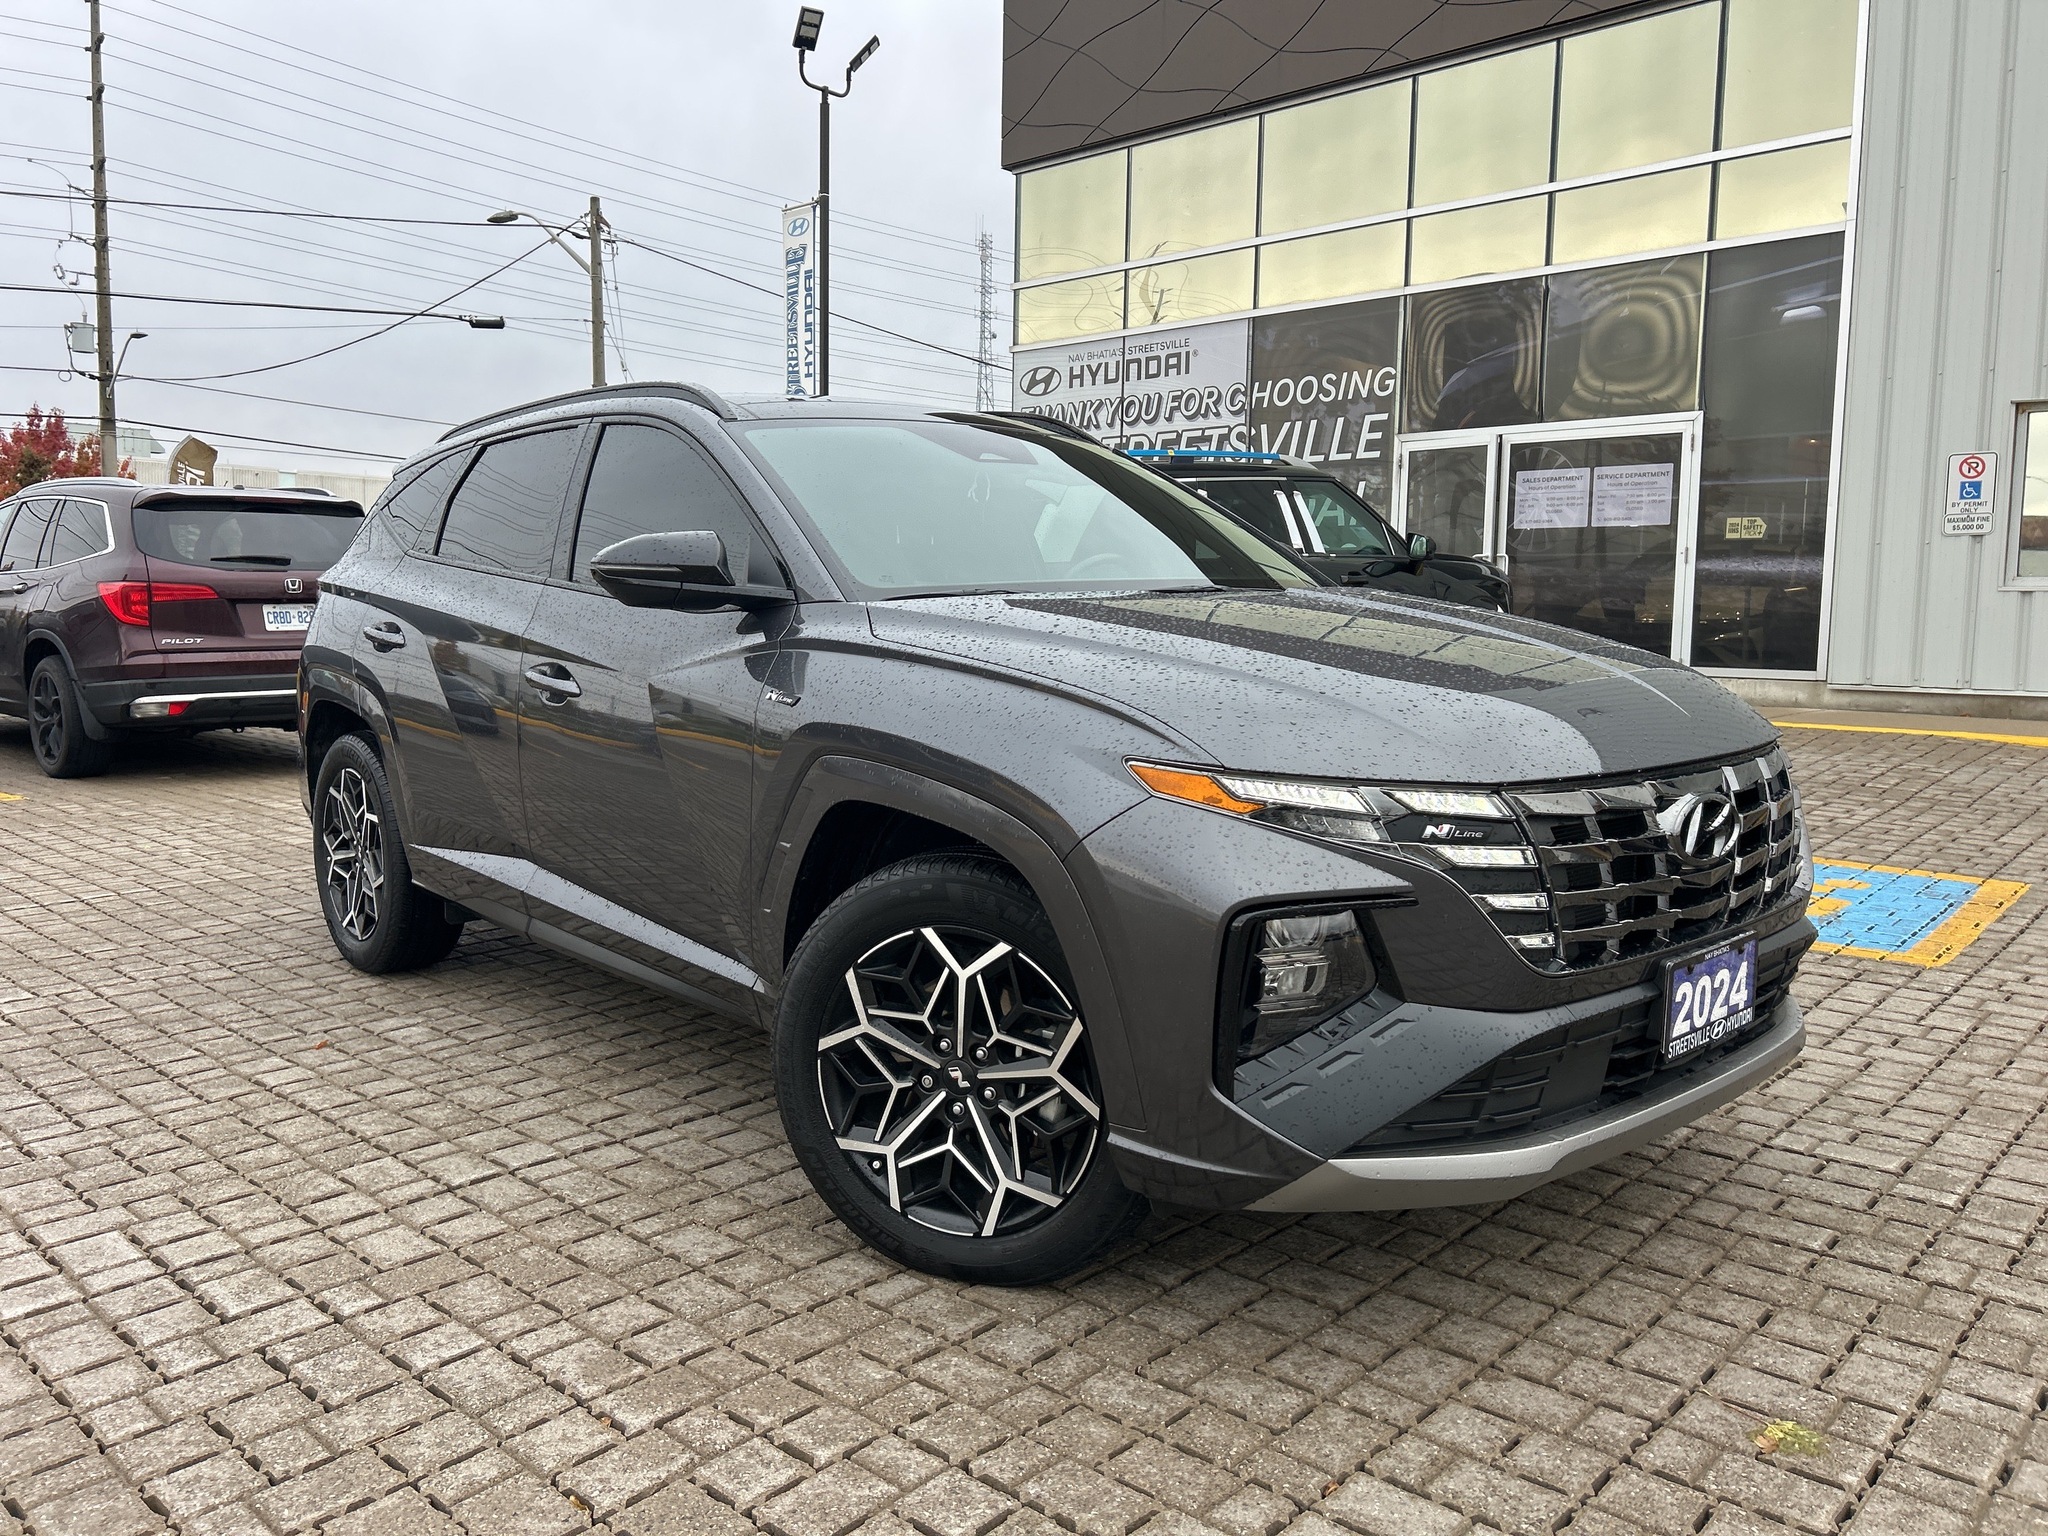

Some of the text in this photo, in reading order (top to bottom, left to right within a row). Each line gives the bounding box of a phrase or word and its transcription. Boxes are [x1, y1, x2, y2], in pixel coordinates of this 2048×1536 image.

[804, 268, 813, 378] HYUNDAI
[1068, 338, 1190, 363] NAV BHATIA'S STREETSVILLE
[1104, 392, 1161, 427] YOU
[1164, 384, 1220, 422] FOR
[1225, 366, 1397, 414] CHOOSING
[1541, 475, 1584, 483] DEPARTMENT
[1624, 471, 1670, 479] DEPARTMENT
[1947, 515, 1976, 524] MAXIMUM
[266, 611, 292, 625] CRBD
[161, 637, 204, 645] PILOT
[1454, 830, 1484, 838] Line
[1672, 960, 1748, 1039] 2024
[1668, 1006, 1753, 1059] STREETSVILLE HYUNDAI
